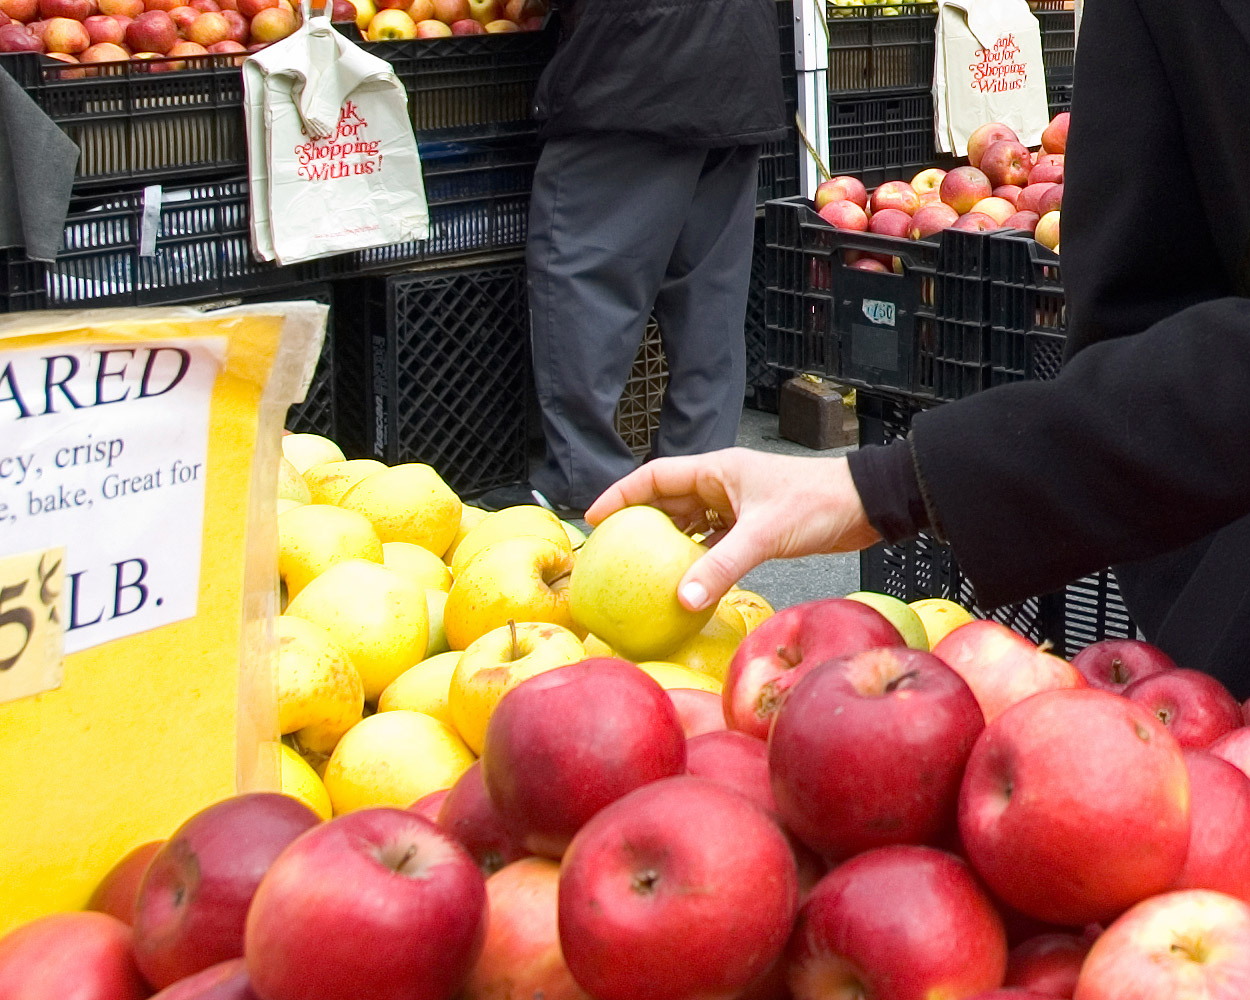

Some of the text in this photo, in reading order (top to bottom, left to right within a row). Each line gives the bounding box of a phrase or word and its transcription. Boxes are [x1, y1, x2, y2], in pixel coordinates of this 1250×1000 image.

[974, 49, 1020, 64] You for
[968, 61, 1027, 81] Shopping
[971, 78, 1007, 93] With
[294, 138, 382, 166] Shopping
[298, 162, 350, 181] With
[55, 434, 125, 468] crisp
[28, 485, 94, 516] bake,
[102, 470, 162, 501] Great
[170, 460, 203, 487] for
[65, 556, 164, 632] LB.
